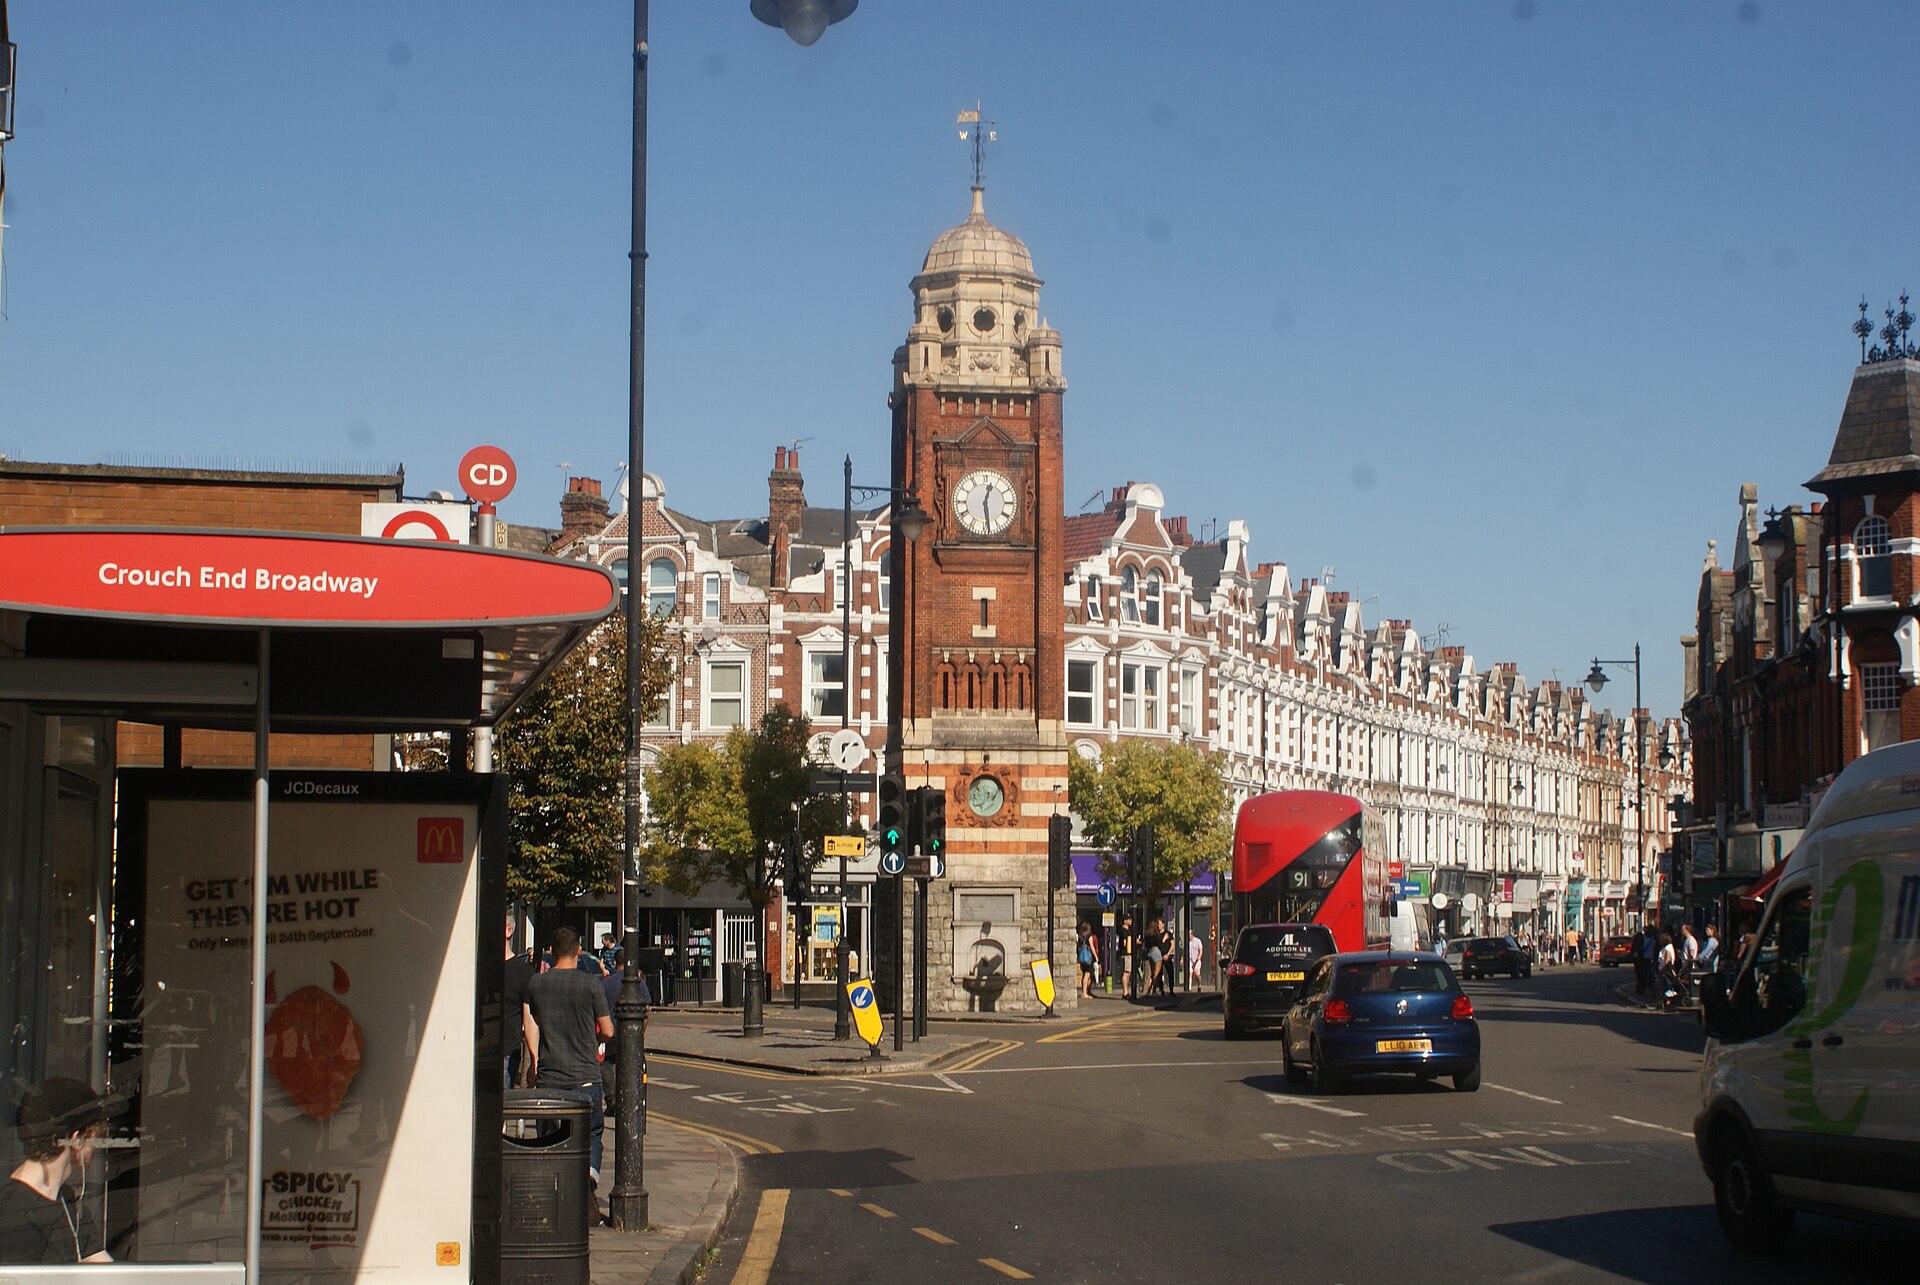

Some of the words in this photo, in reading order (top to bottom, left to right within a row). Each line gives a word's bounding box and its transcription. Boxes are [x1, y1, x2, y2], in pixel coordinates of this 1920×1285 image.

[959, 131, 968, 141] W
[989, 131, 997, 141] E
[469, 463, 508, 486] CD
[98, 562, 191, 588] Crouch
[200, 566, 247, 589] End
[254, 568, 379, 598] Broadway
[283, 781, 360, 795] JCDecaux
[186, 878, 239, 901] GET
[243, 874, 290, 896] 'M
[295, 869, 379, 893] WHILE
[1294, 872, 1308, 887] 91
[187, 902, 298, 928] THEYRE
[305, 898, 360, 921] HOT
[189, 936, 217, 950] Only
[220, 937, 247, 947] here
[279, 931, 306, 943] 24th
[308, 927, 375, 942] September
[1384, 1041, 1405, 1050] LL10
[1408, 1041, 1426, 1050] AEW
[271, 1171, 353, 1194] SPICY
[278, 1195, 343, 1211] CHICKEN
[290, 1233, 311, 1243] spicy
[312, 1233, 341, 1241] tomato
[342, 1233, 356, 1243] dip
